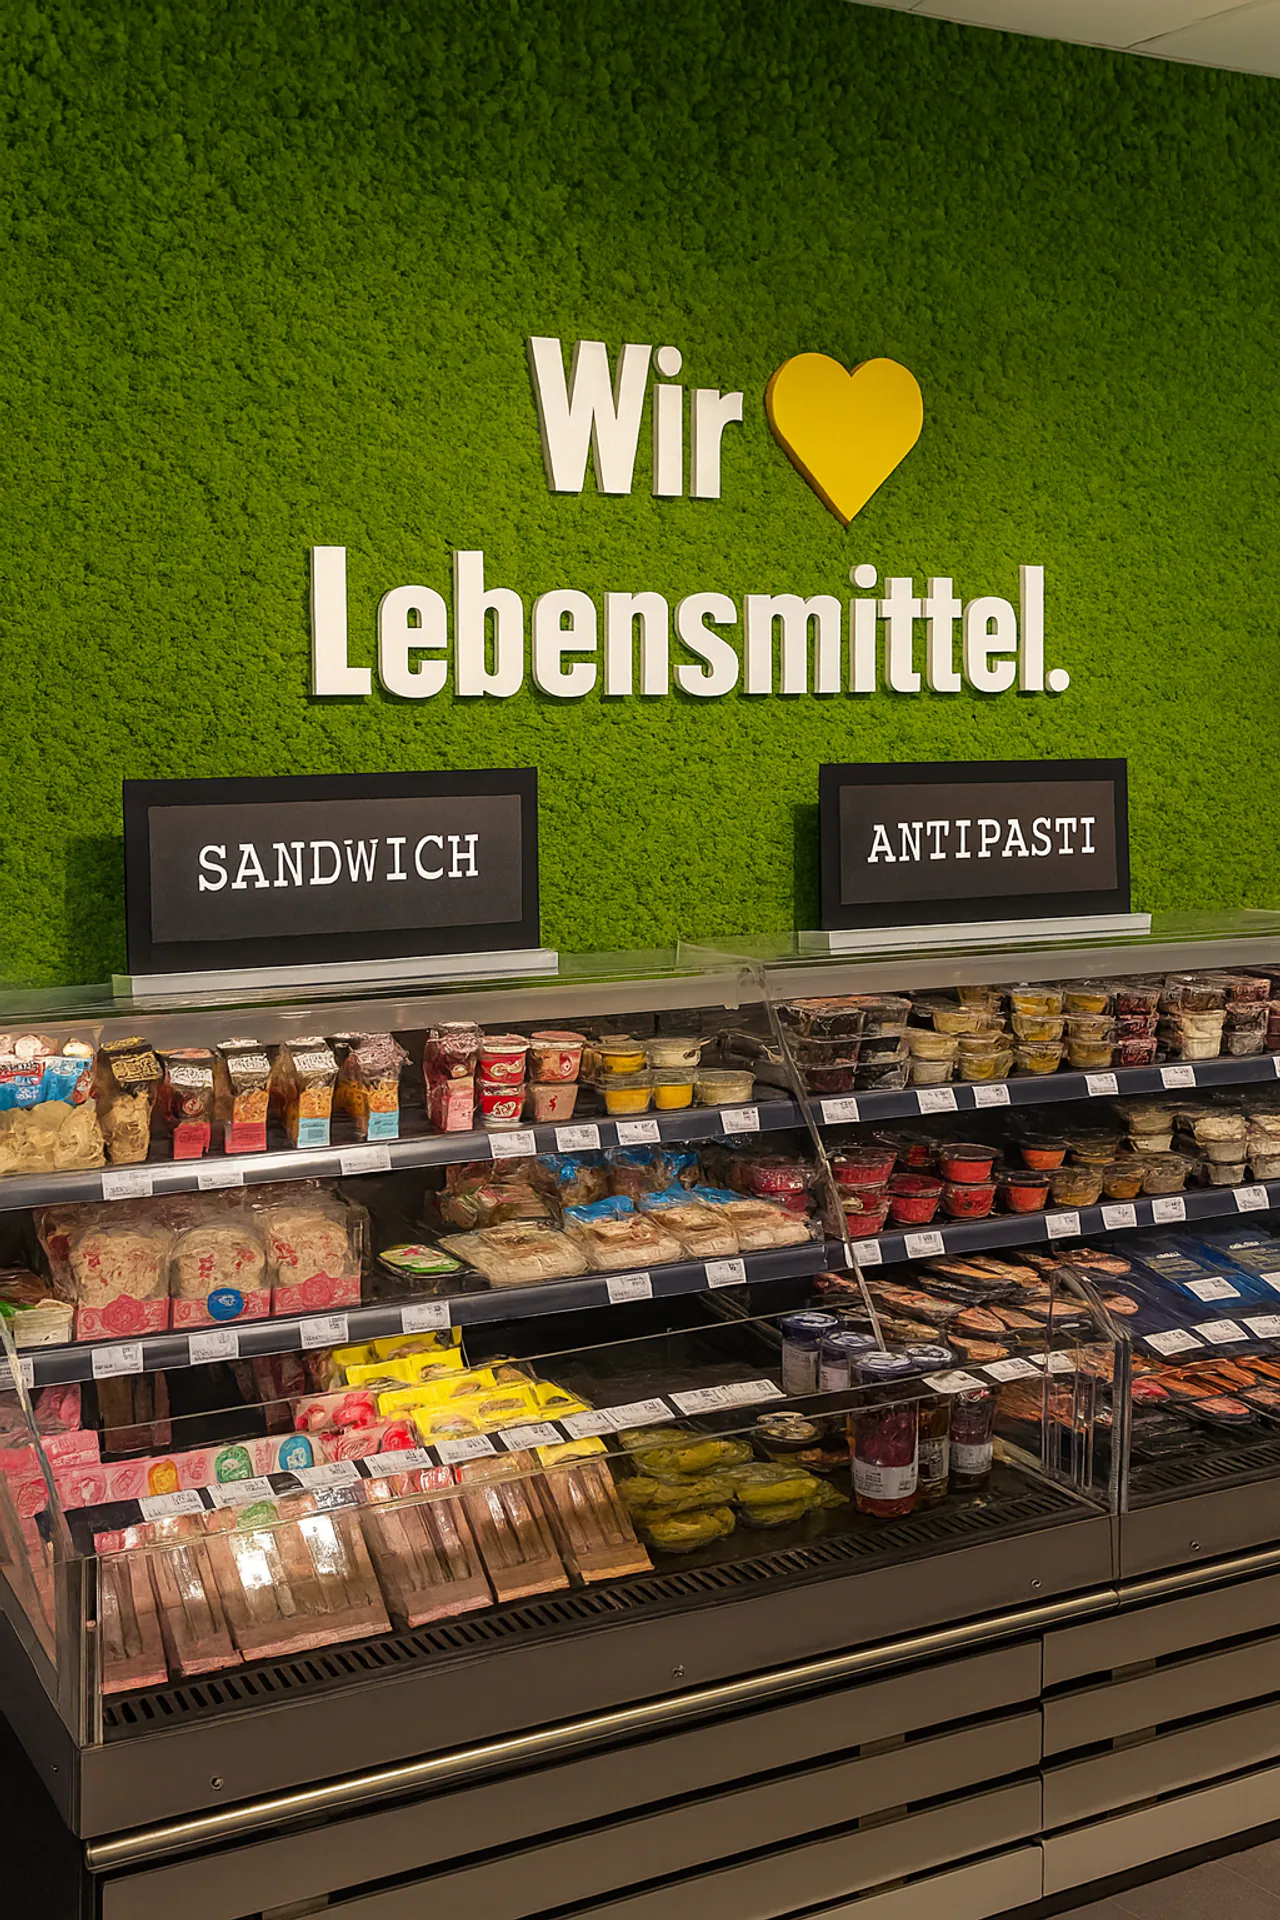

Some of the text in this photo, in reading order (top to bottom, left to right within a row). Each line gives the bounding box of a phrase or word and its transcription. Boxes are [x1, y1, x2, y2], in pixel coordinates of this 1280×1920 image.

[528, 336, 743, 499] Wir
[310, 545, 1070, 699] Lebensmittel.
[198, 833, 479, 892] SANDWICH
[867, 817, 1096, 863] ANTIPASTI
